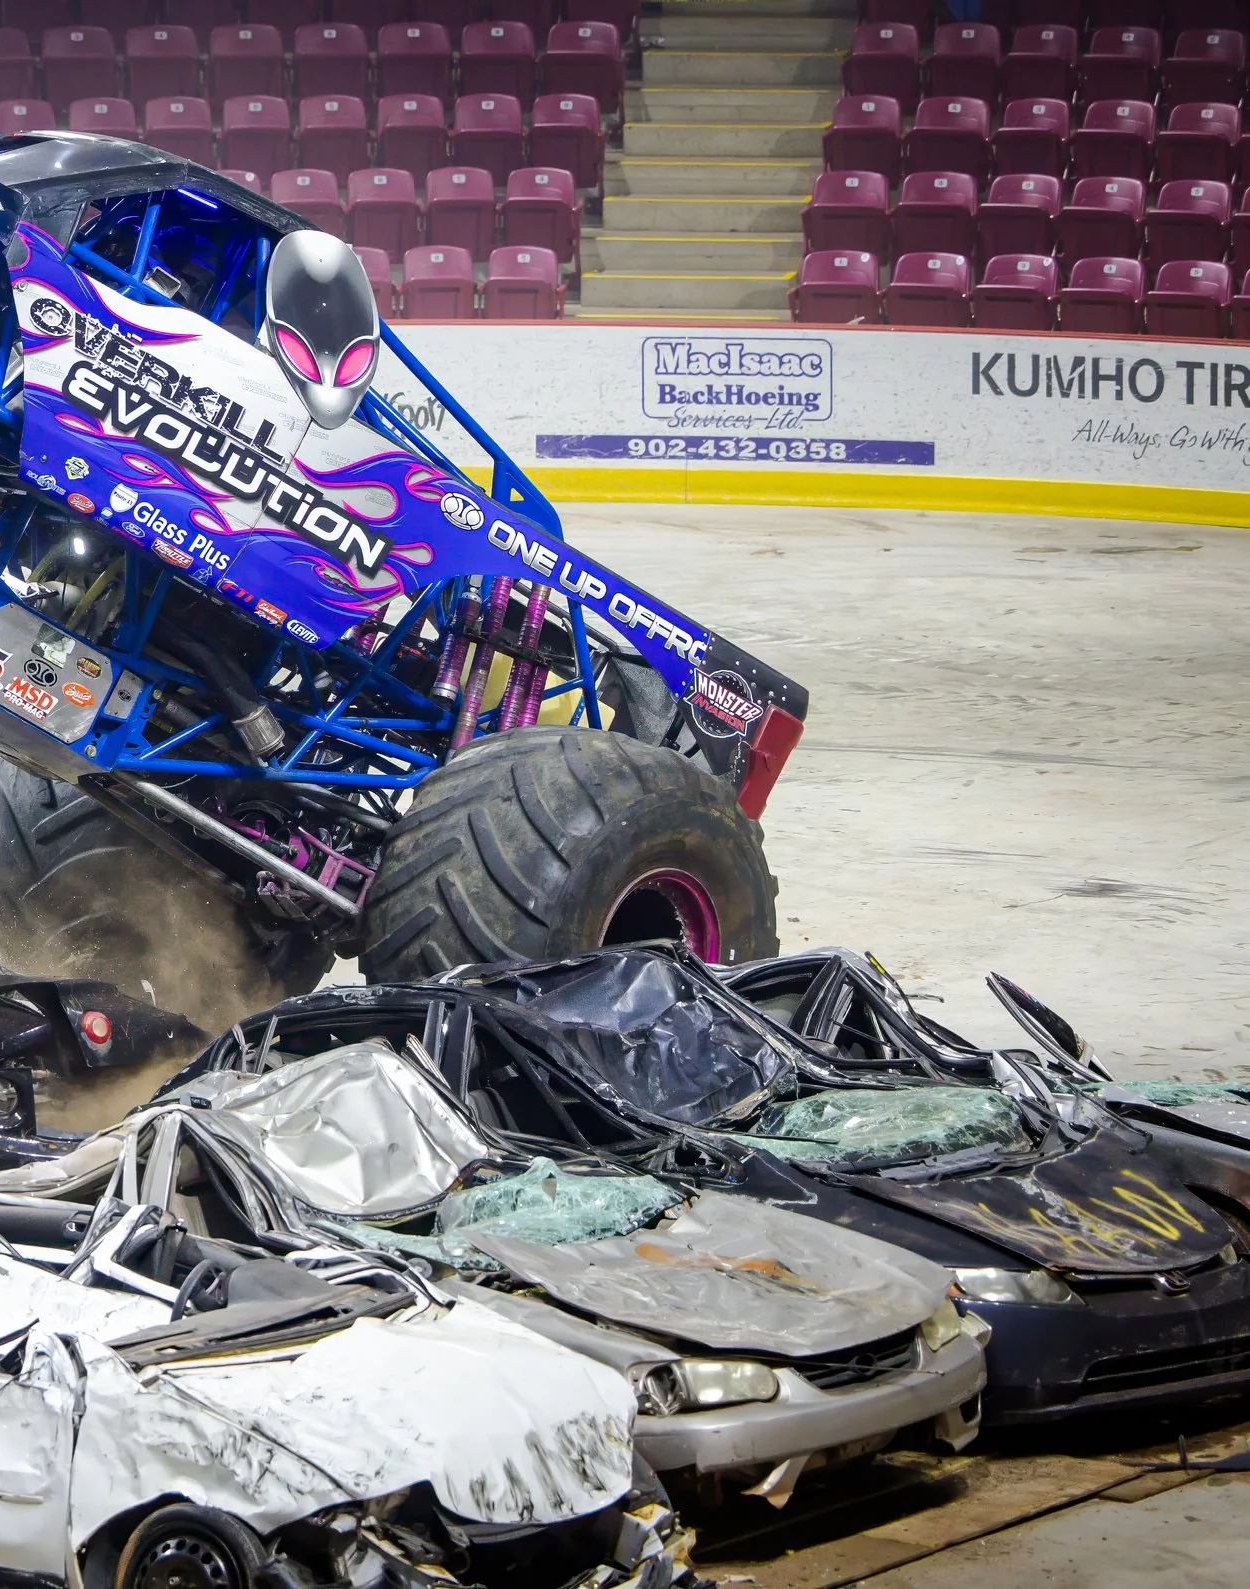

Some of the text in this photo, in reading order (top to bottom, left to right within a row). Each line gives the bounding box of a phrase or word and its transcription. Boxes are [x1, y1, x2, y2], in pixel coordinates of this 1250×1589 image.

[654, 342, 823, 377] MacIsaac
[971, 351, 1250, 408] KUMHO TIR
[29, 297, 287, 464] OVERKILL
[657, 383, 822, 412] BackHoeing
[667, 406, 804, 430] Services Ltd.
[66, 364, 388, 571] EVOLUTION
[627, 438, 847, 461] 902-432-0358
[133, 501, 188, 545] Glass
[188, 533, 230, 570] Plus
[487, 519, 558, 579] ONE
[558, 560, 607, 601] UP
[286, 619, 319, 644] CLEVITE
[9, 676, 55, 712] MSD
[691, 692, 746, 732] INVASION
[697, 672, 762, 721] MONSTER
